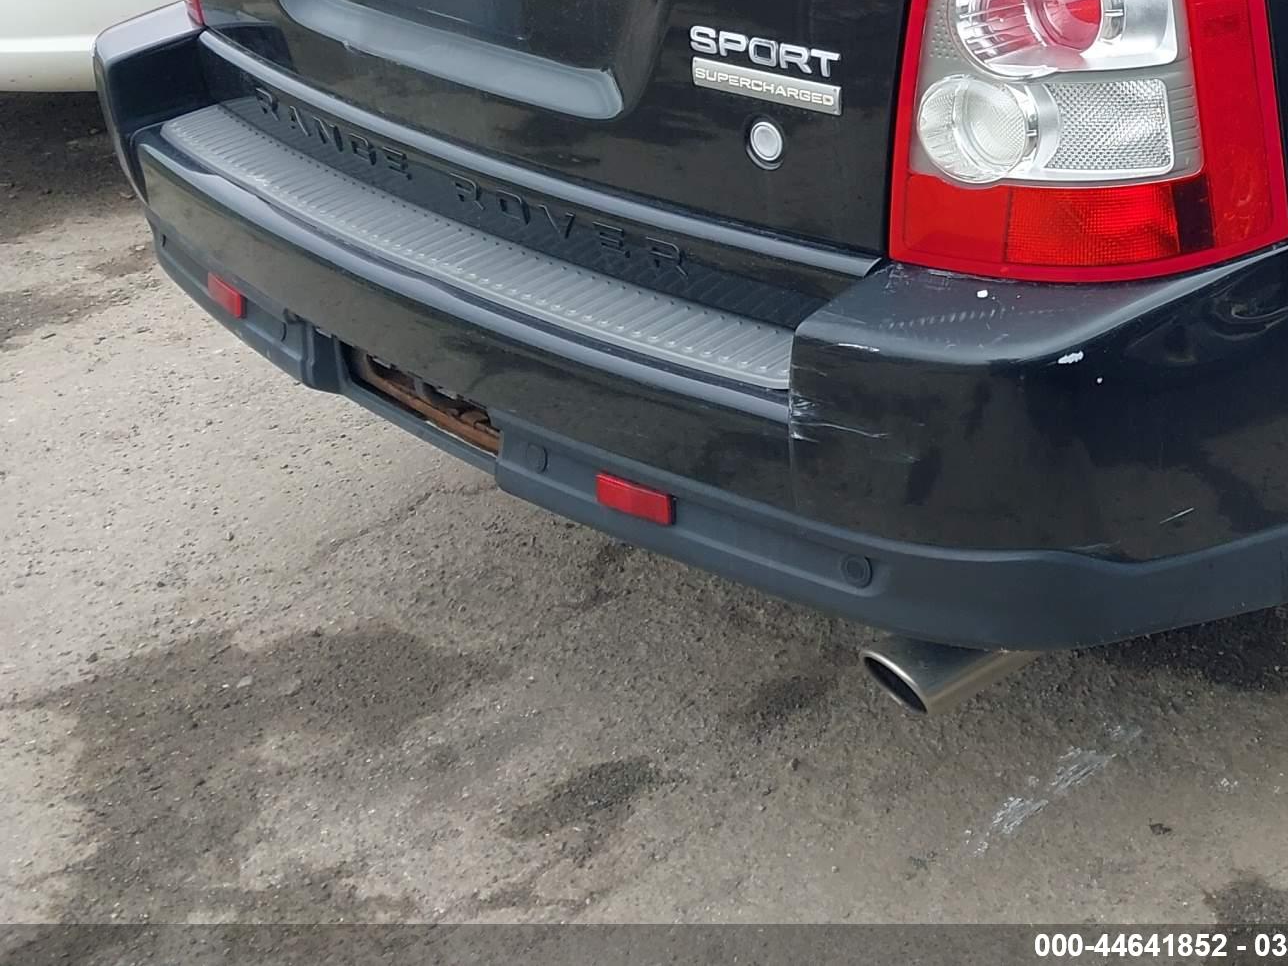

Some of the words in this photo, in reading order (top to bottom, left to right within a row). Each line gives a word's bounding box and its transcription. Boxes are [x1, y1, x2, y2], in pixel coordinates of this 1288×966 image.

[690, 25, 840, 78] SPORT
[695, 67, 835, 107] SUPERCHARGED
[254, 86, 411, 177] RANGE
[449, 172, 690, 279] ROVER
